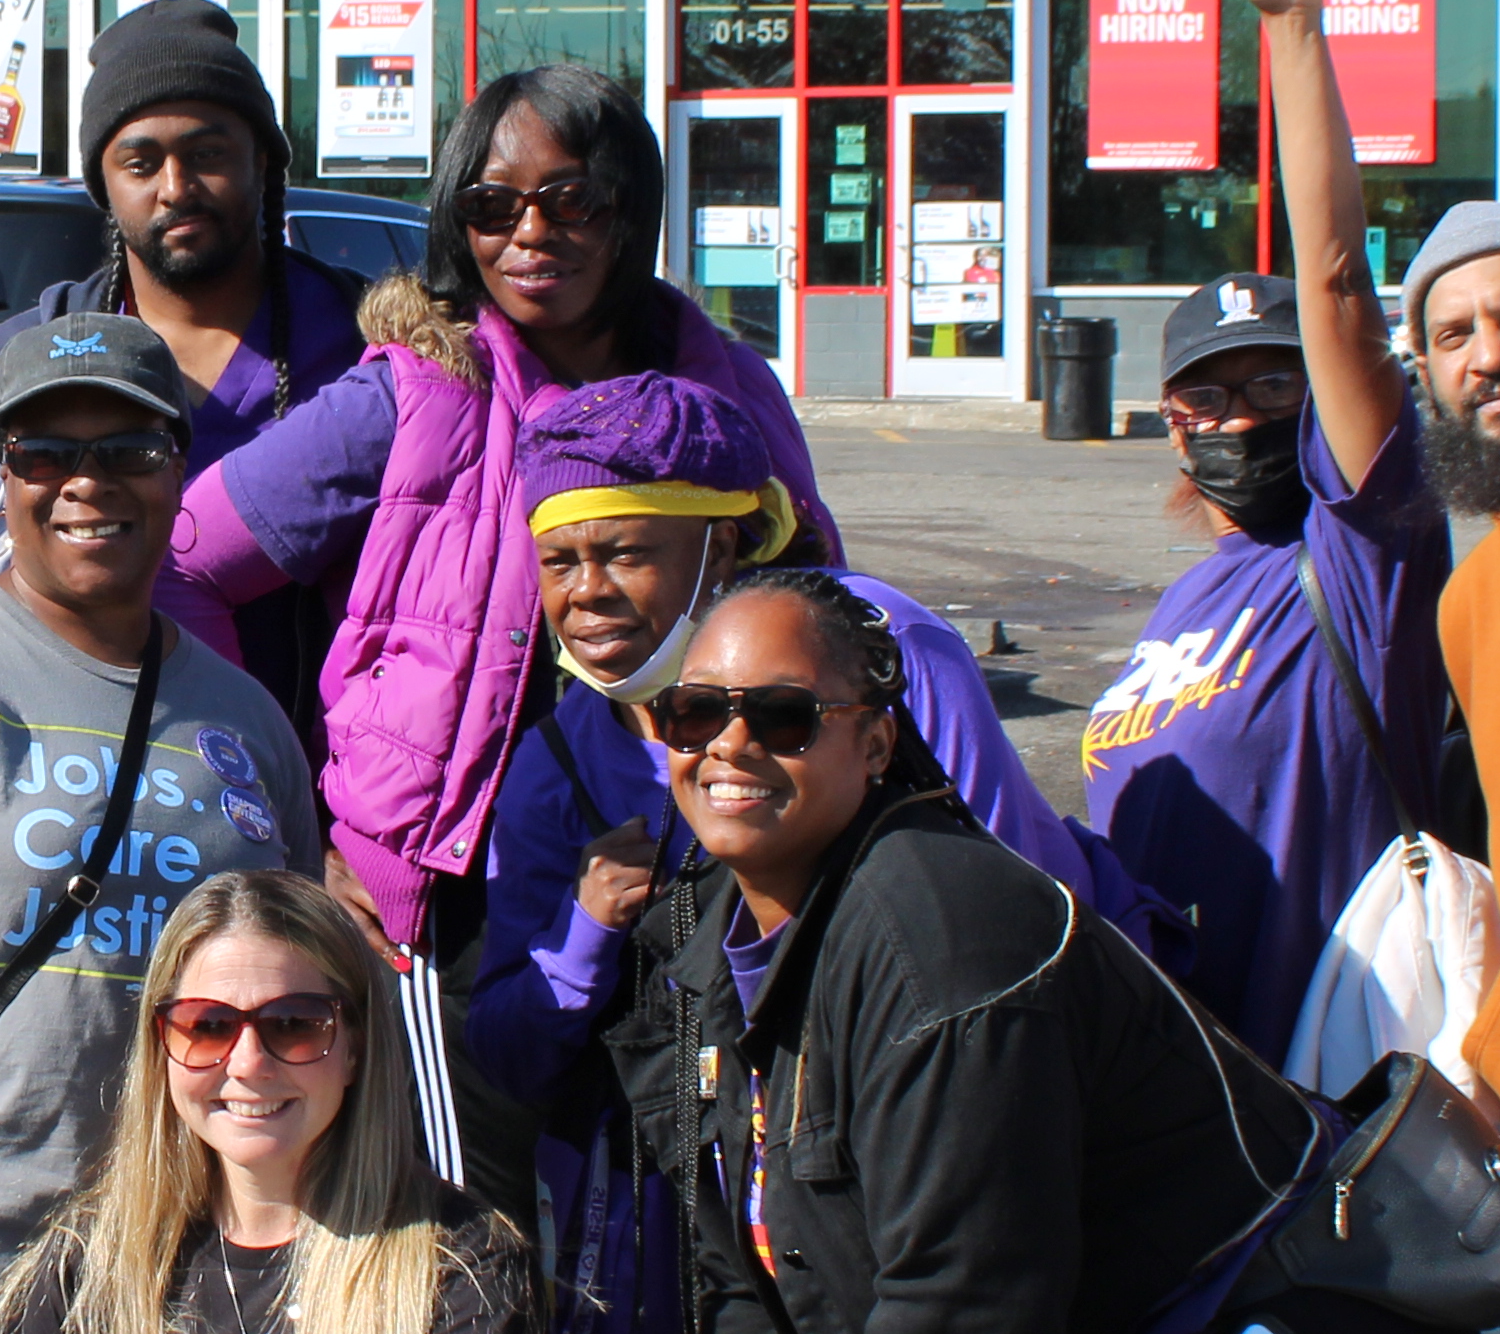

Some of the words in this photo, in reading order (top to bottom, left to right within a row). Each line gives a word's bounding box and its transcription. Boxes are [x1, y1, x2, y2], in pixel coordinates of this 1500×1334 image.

[341, 4, 369, 27] $15
[371, 5, 401, 14] BONUS
[371, 14, 410, 24] REWARD
[1100, 13, 1204, 43] HIRING!
